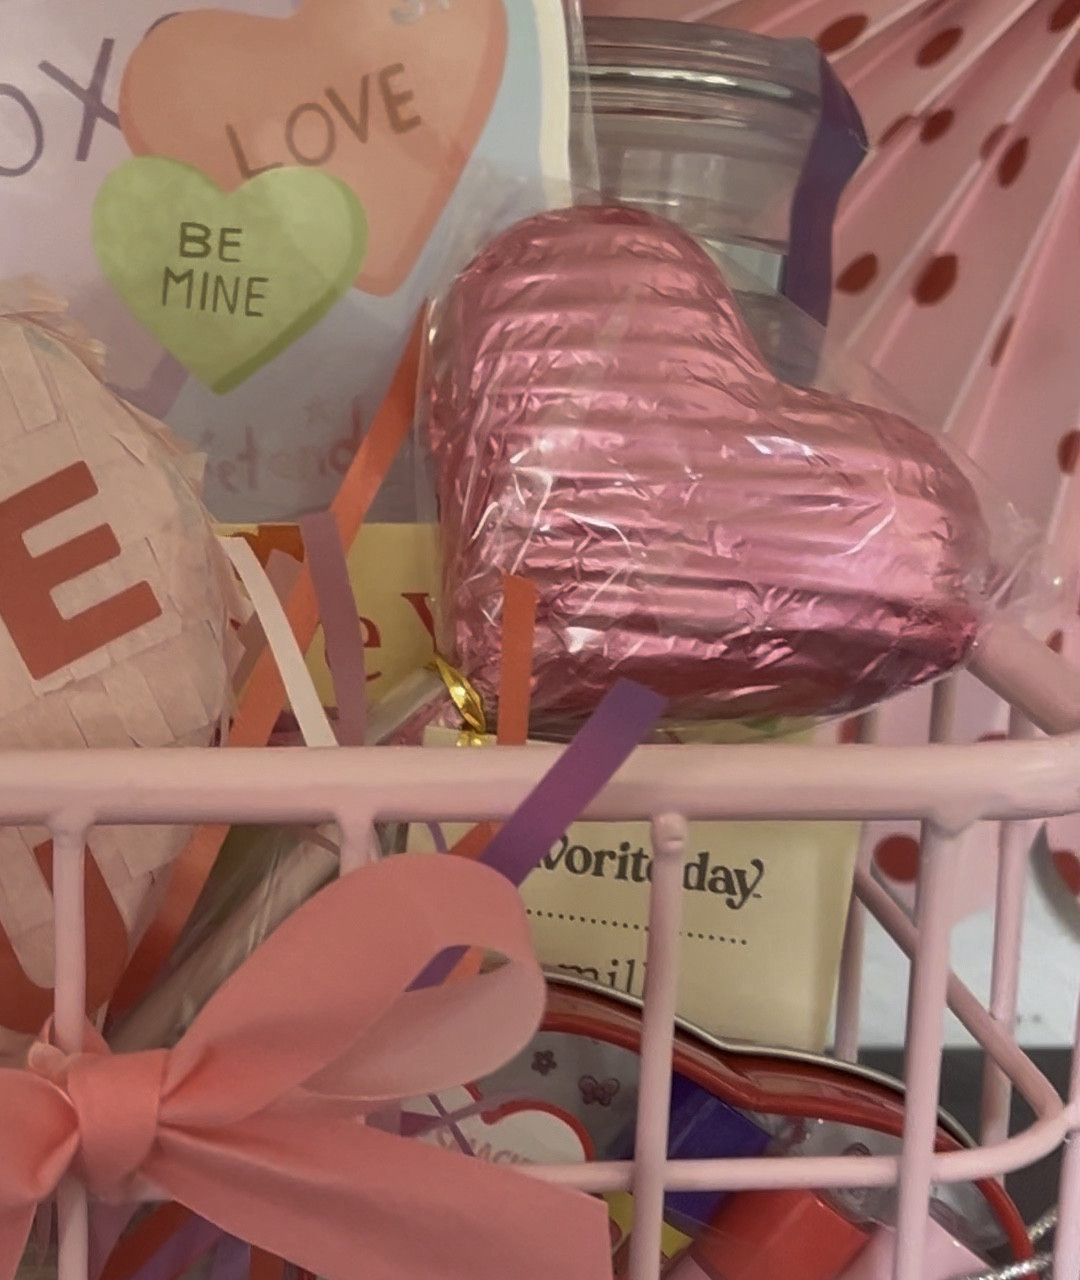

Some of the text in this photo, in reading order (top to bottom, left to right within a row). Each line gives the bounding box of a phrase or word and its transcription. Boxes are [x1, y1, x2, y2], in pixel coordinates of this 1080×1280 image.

[224, 61, 422, 182] LOVE
[178, 220, 243, 264] BE
[161, 266, 270, 318] MINE
[683, 852, 765, 910] day
